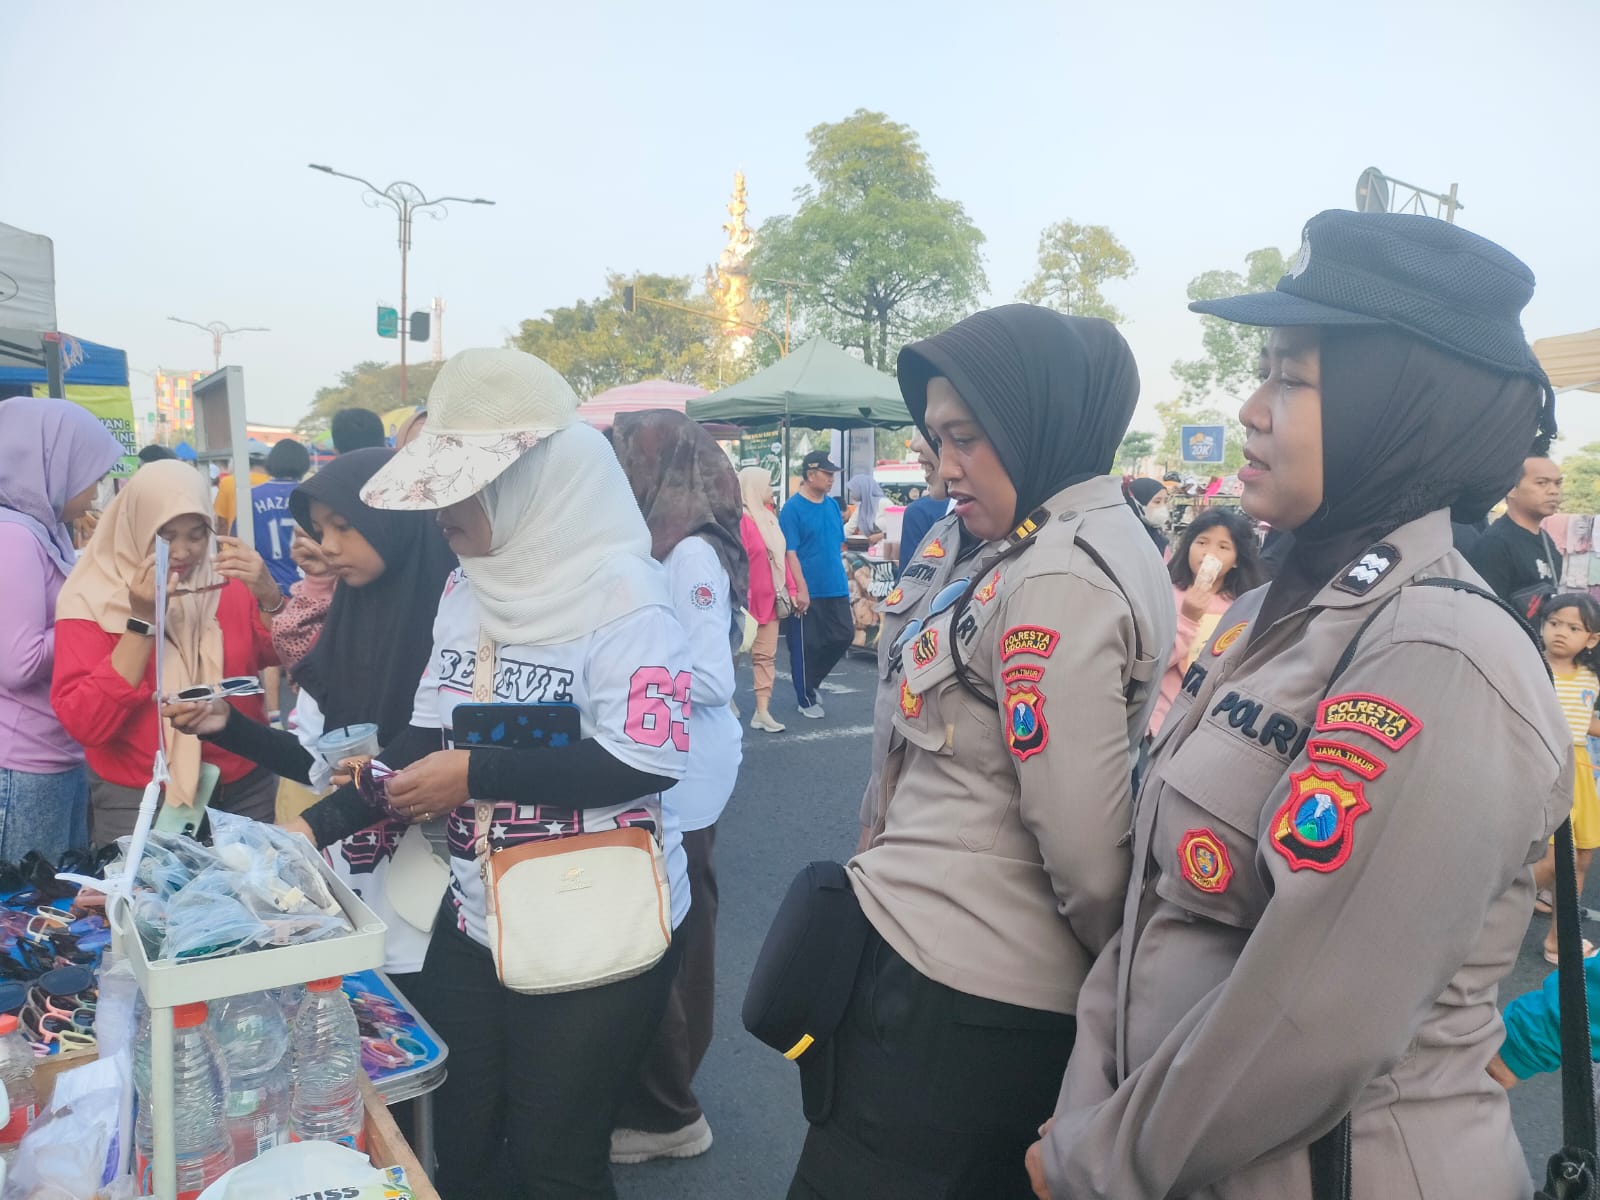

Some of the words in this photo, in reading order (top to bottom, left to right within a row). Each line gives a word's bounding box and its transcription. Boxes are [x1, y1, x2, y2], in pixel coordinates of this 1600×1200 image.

[267, 517, 297, 560] 17
[1212, 691, 1311, 760] POLRI
[1327, 701, 1407, 731] POLRESTA
[1327, 713, 1397, 738] SIDOARJO
[1316, 747, 1342, 758] JAWA
[1346, 752, 1375, 772] TIMUR
